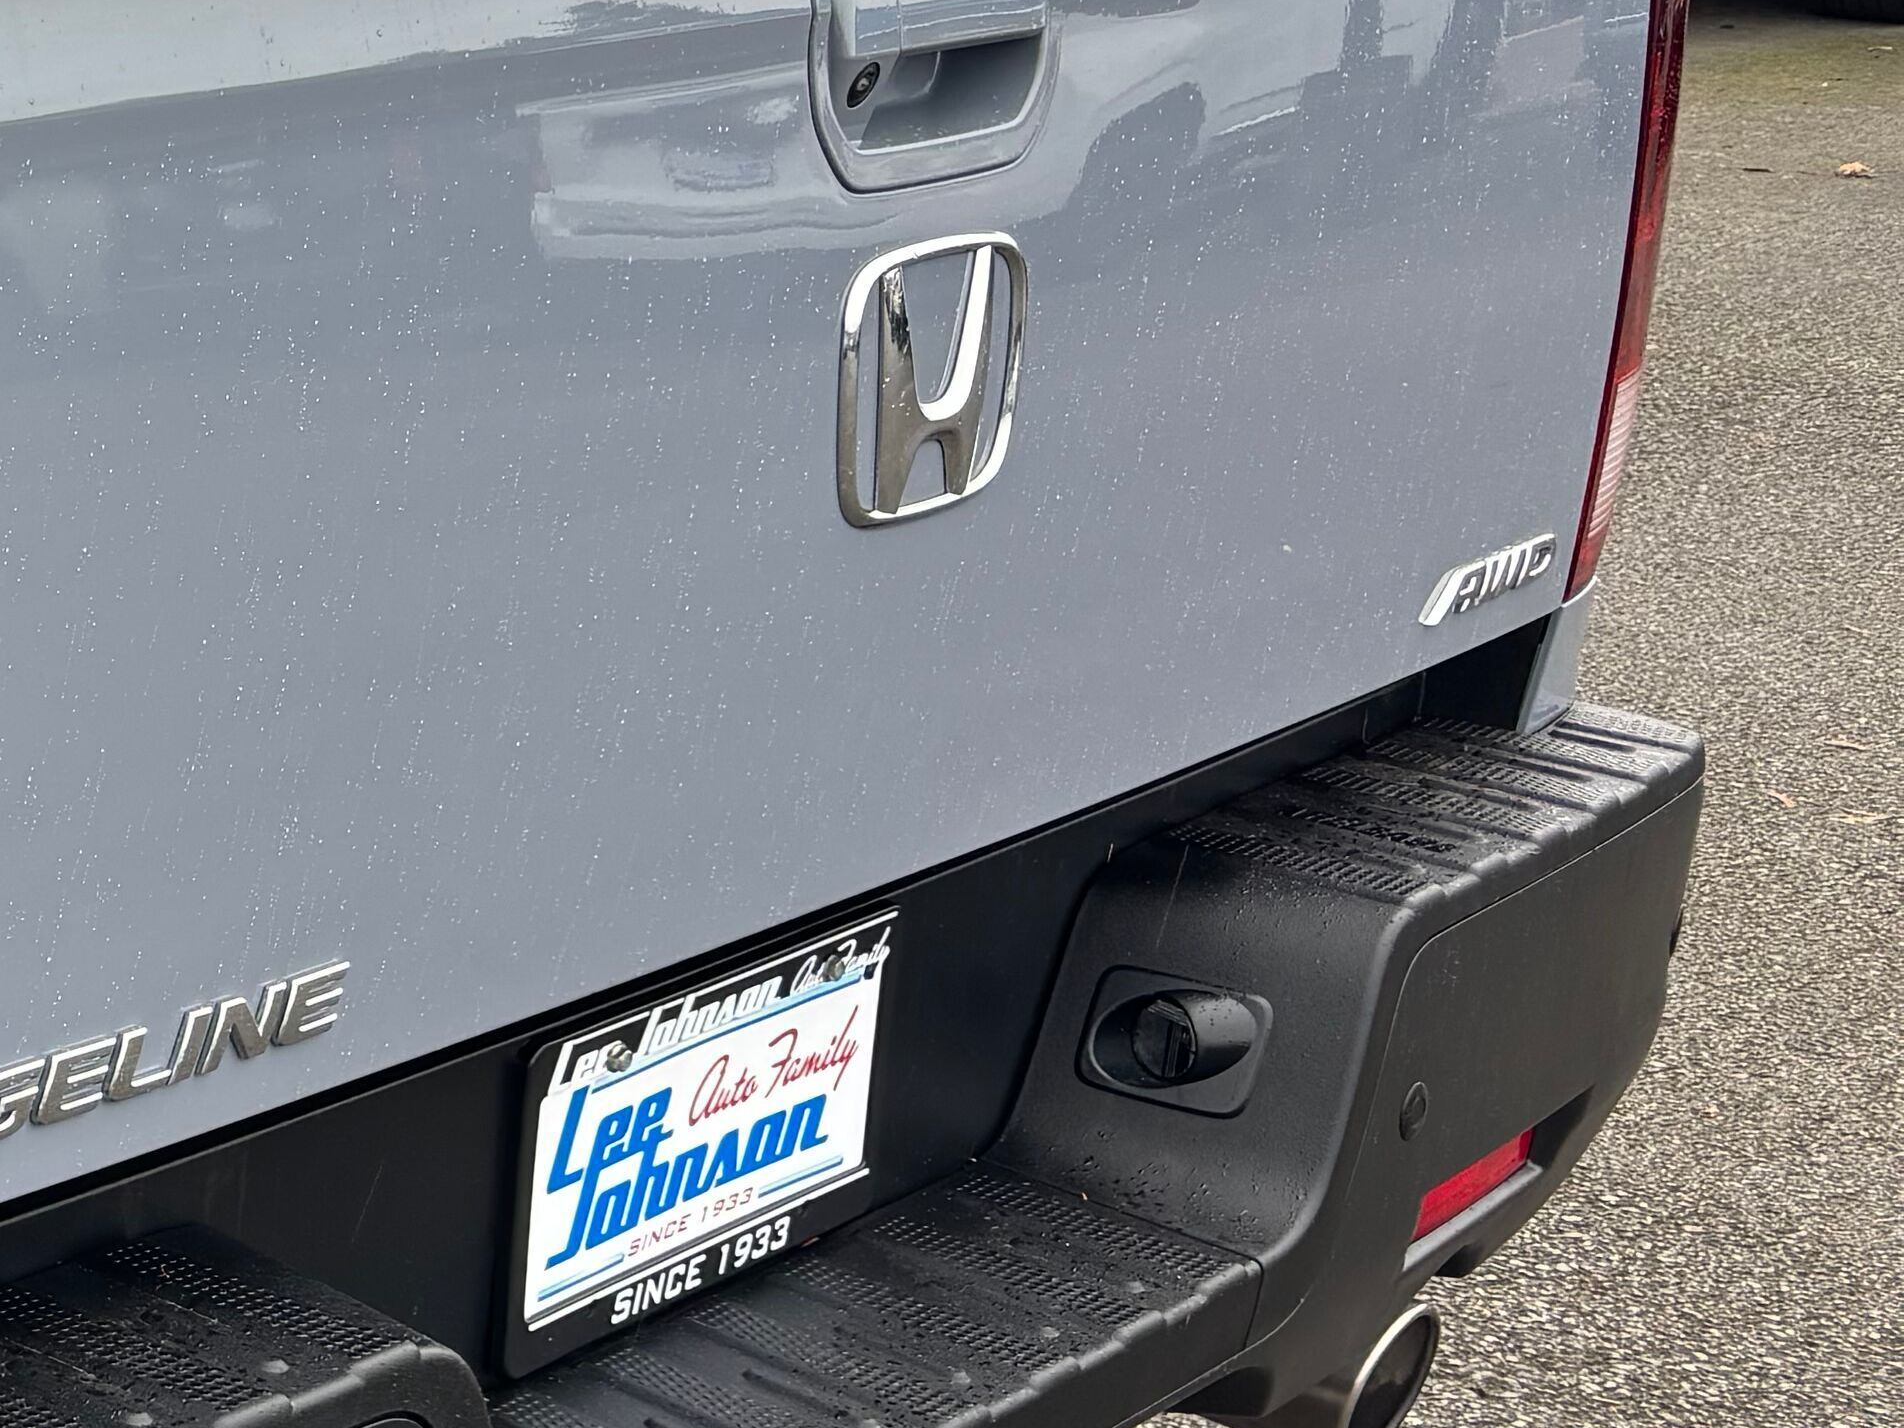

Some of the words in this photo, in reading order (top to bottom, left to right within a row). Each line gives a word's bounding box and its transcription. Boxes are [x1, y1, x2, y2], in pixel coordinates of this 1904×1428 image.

[1418, 533, 1556, 626] AWD
[548, 1039, 633, 1098] Le
[636, 975, 784, 1057] Johnson
[546, 1085, 674, 1195] Lee
[688, 1054, 758, 1127] Auto
[763, 1005, 859, 1099] Family
[544, 1093, 829, 1271] Johnson
[627, 1217, 688, 1257] SINCE
[700, 1186, 754, 1224] 1933
[610, 1254, 706, 1325] SINCE
[717, 1216, 791, 1276] 1933
